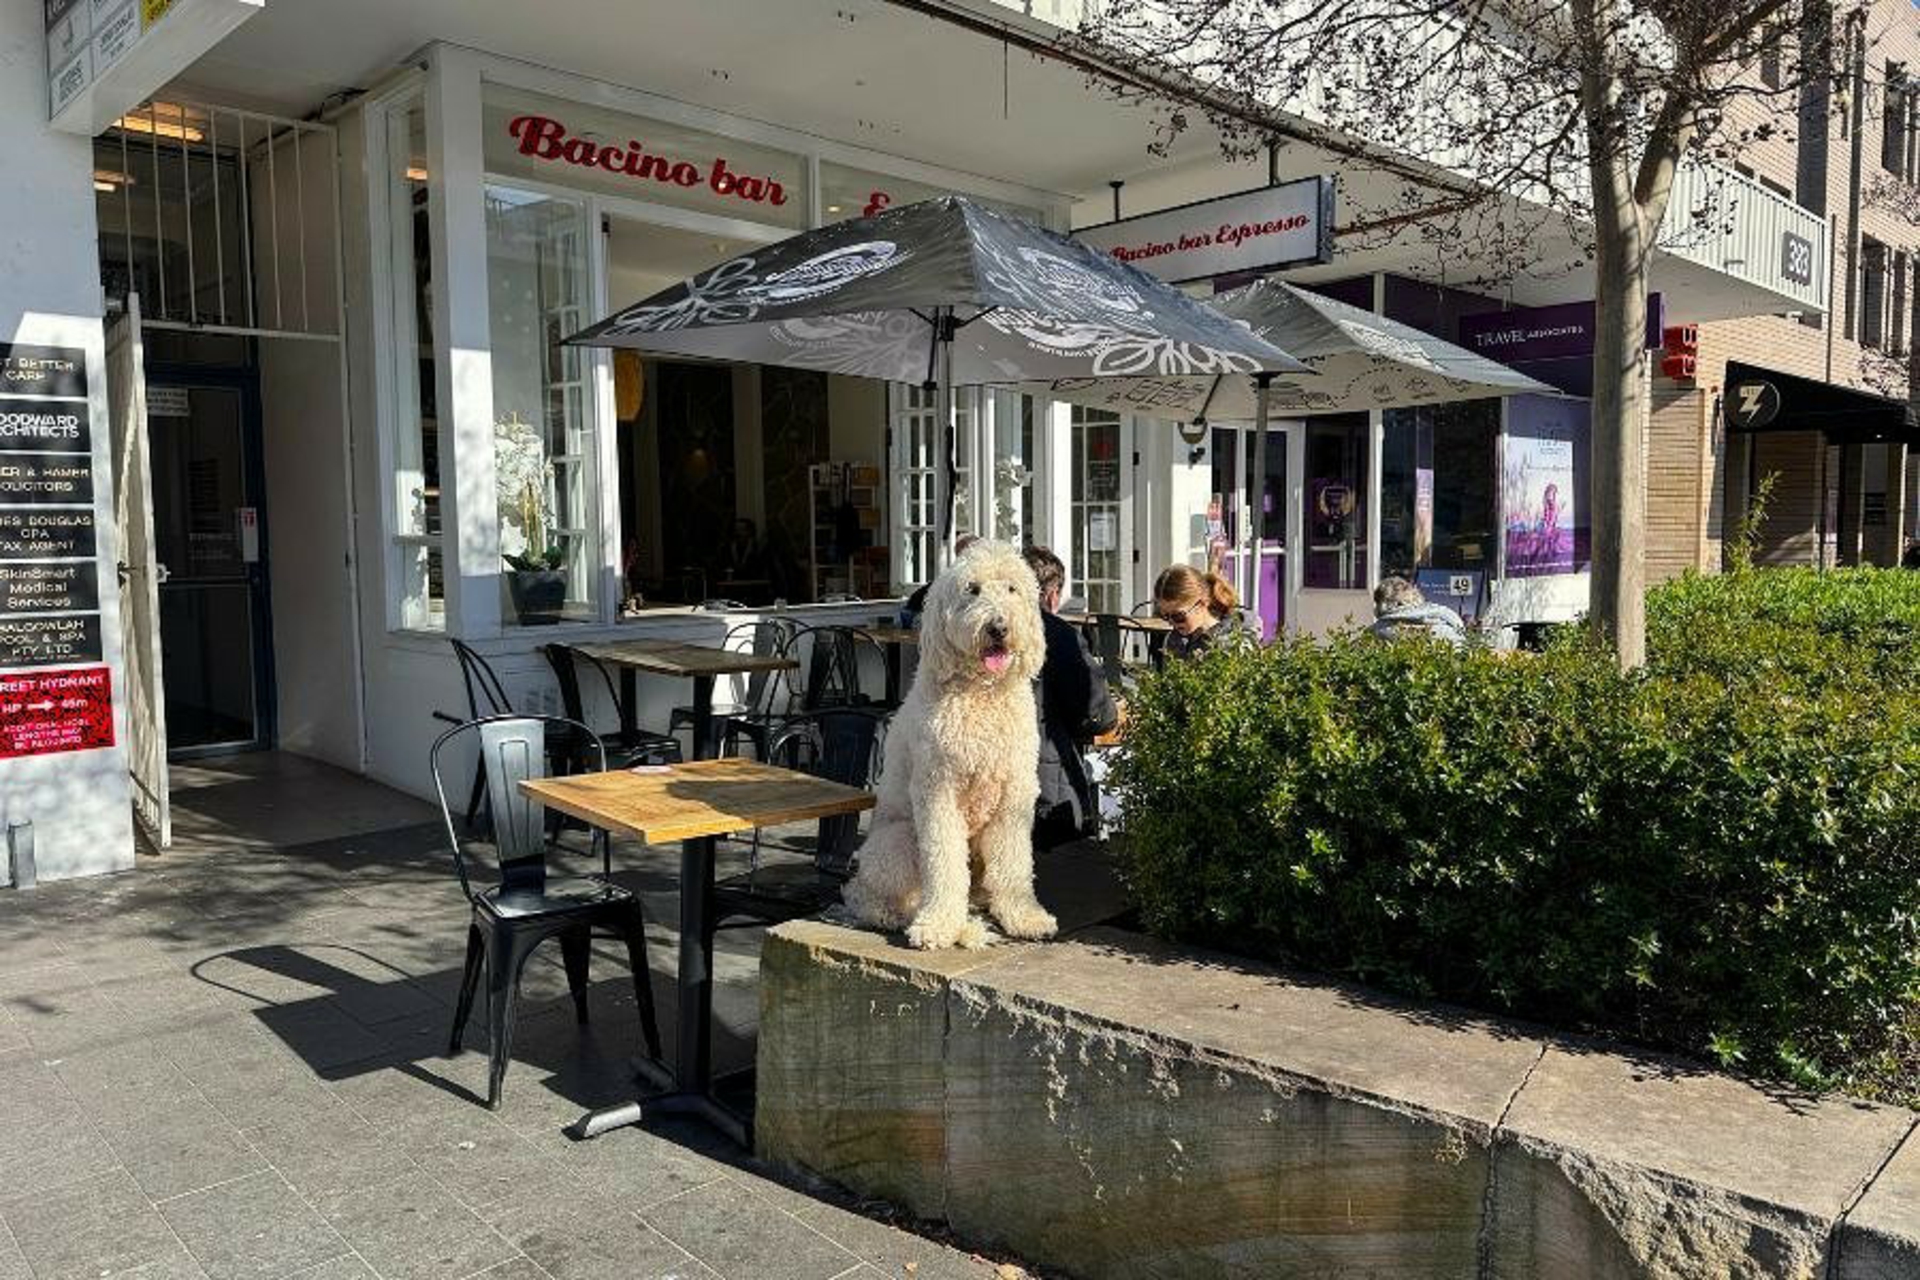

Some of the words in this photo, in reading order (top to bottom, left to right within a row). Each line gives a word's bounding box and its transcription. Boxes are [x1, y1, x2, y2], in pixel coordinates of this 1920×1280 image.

[508, 115, 703, 188] Bacino
[710, 158, 788, 206] bar
[1178, 234, 1212, 252] bar
[1215, 214, 1311, 247] Espresso
[1475, 330, 1526, 346] TRAVEL
[0, 424, 80, 438] CHITECTS
[29, 515, 92, 526] DOUGLAS
[21, 528, 50, 539] CPA
[29, 541, 74, 551] AGENT
[0, 567, 76, 580] SkinSmart
[9, 582, 68, 594] Medical
[7, 597, 72, 609] Services
[59, 631, 86, 641] SPA
[12, 645, 39, 656] PTY
[46, 643, 73, 654] LTD
[39, 675, 104, 689] HYDRANT
